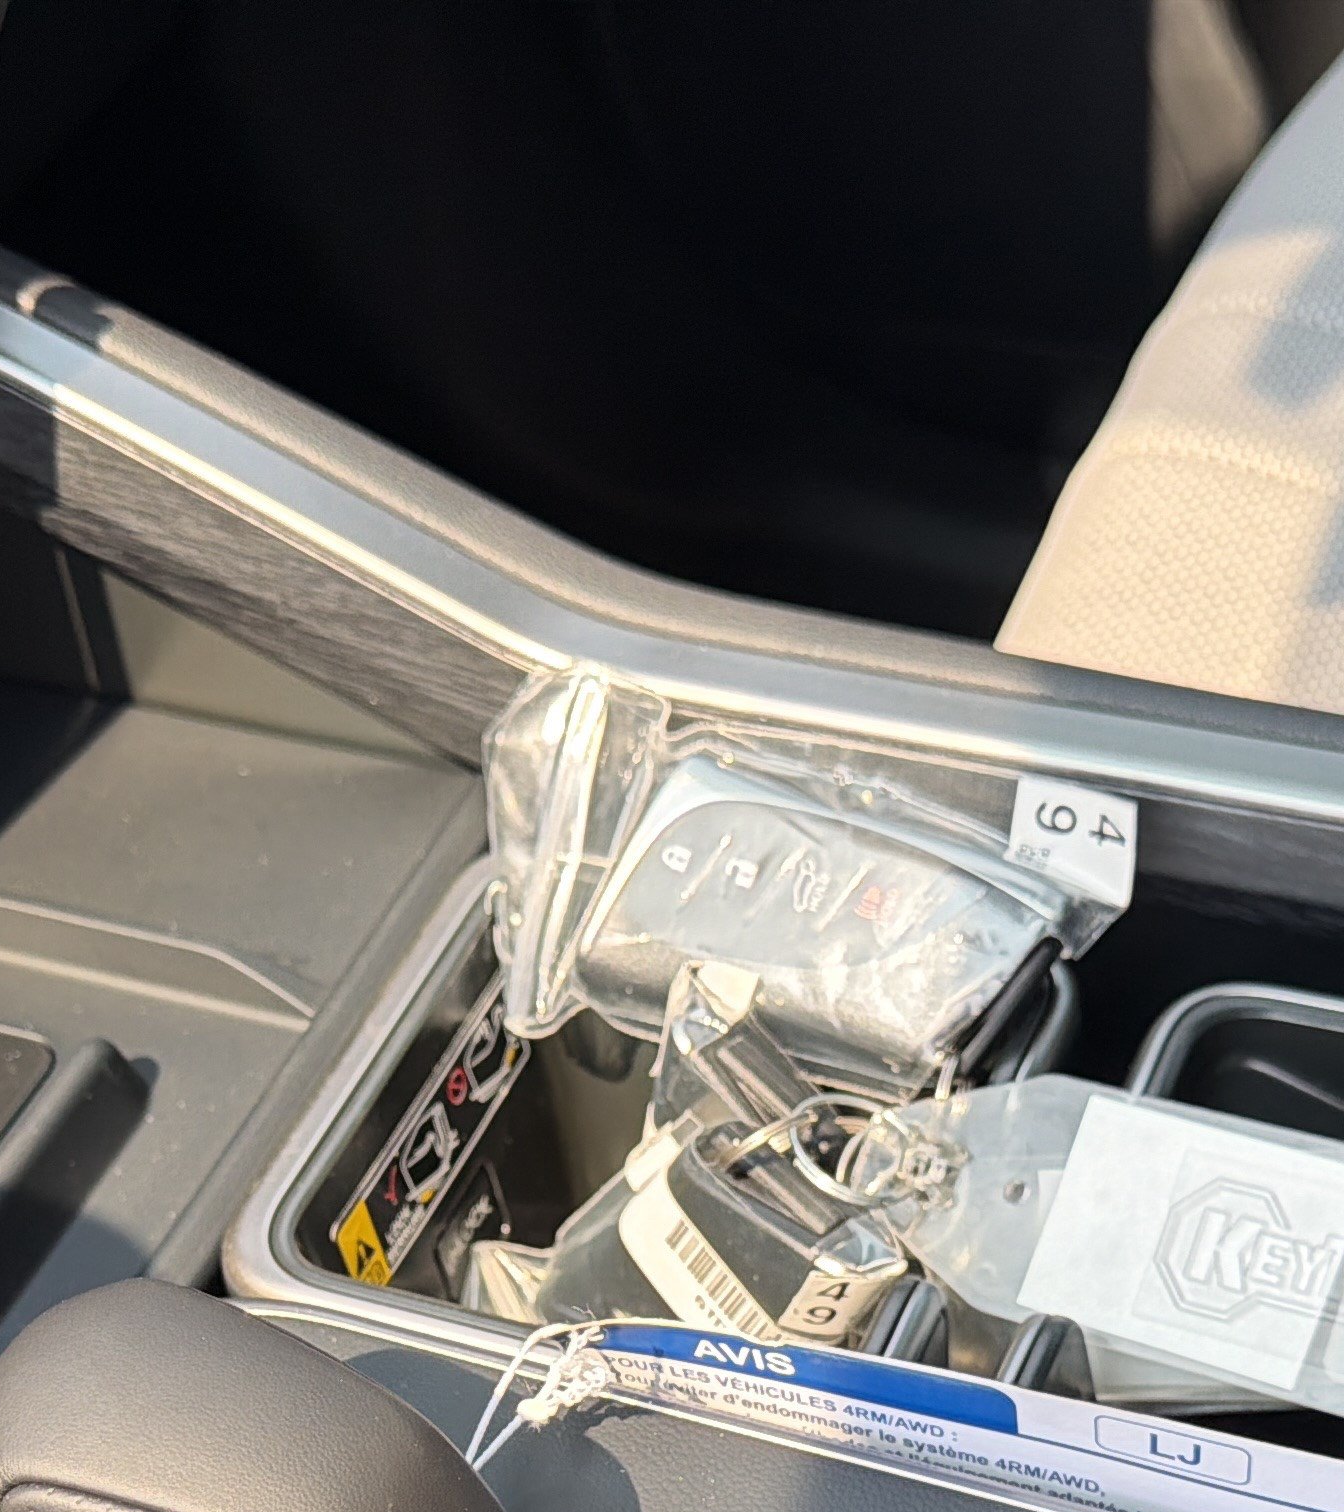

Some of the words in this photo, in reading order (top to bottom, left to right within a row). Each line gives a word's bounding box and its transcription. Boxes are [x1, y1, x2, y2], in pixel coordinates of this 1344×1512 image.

[693, 1338, 796, 1377] AVIS
[668, 1365, 711, 1384] LES
[714, 1372, 838, 1413] VÉHICULES
[842, 1404, 945, 1438] 4RM/AWD
[722, 1390, 874, 1438] d'endommager
[878, 1428, 897, 1444] le
[903, 1437, 990, 1467] système
[994, 1458, 1107, 1498] 4RM/AWD,
